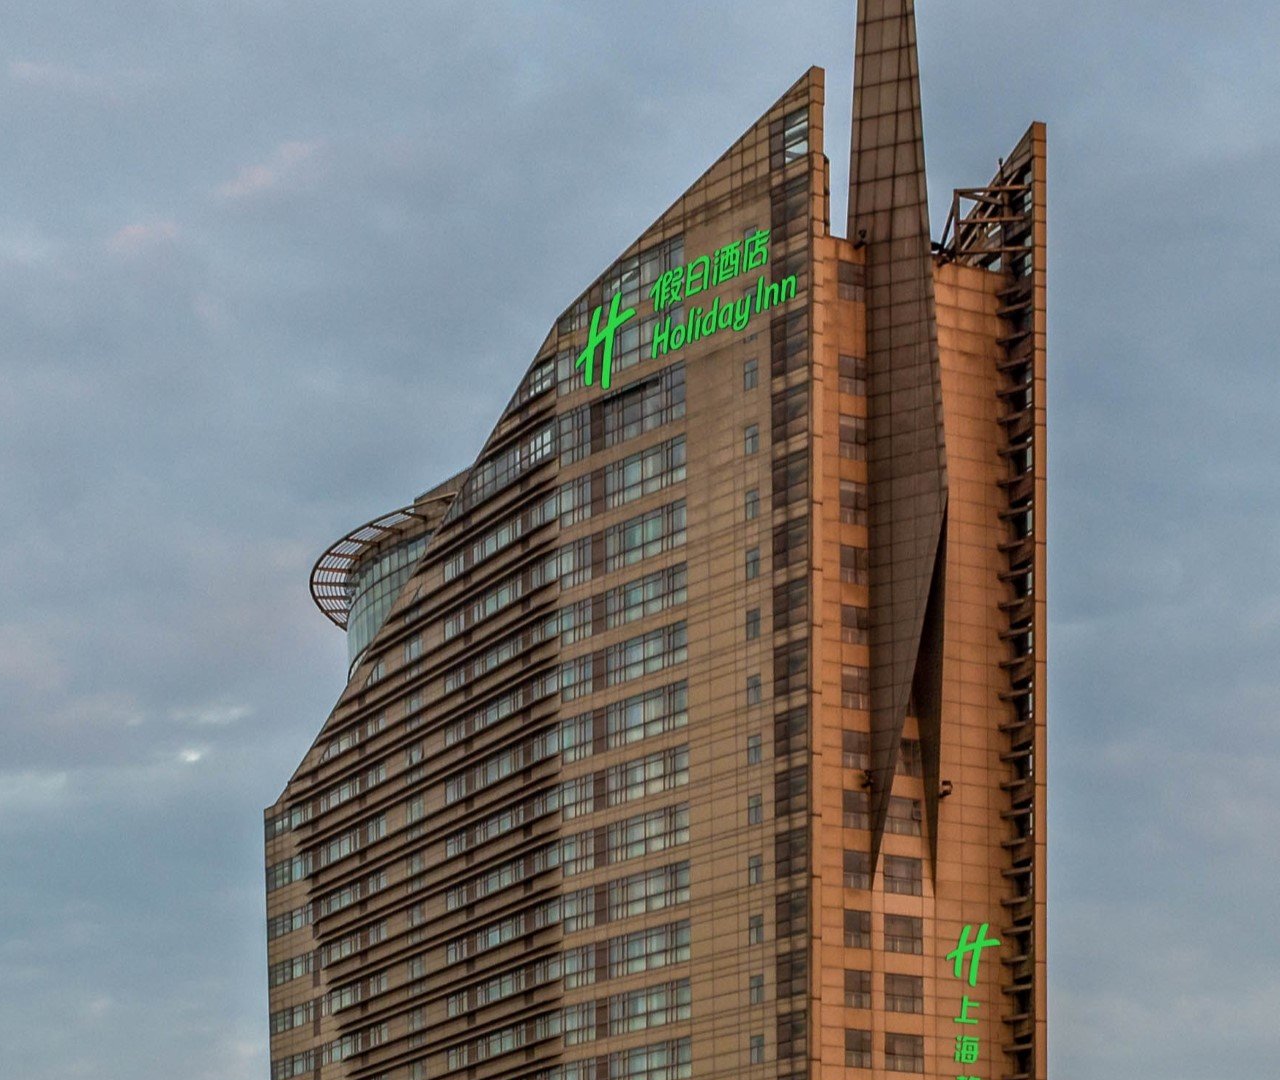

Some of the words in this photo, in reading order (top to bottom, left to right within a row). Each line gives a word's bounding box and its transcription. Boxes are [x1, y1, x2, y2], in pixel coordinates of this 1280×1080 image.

[650, 228, 771, 312] 假日酒店
[651, 293, 750, 360] Holiday
[755, 273, 798, 315] Inn
